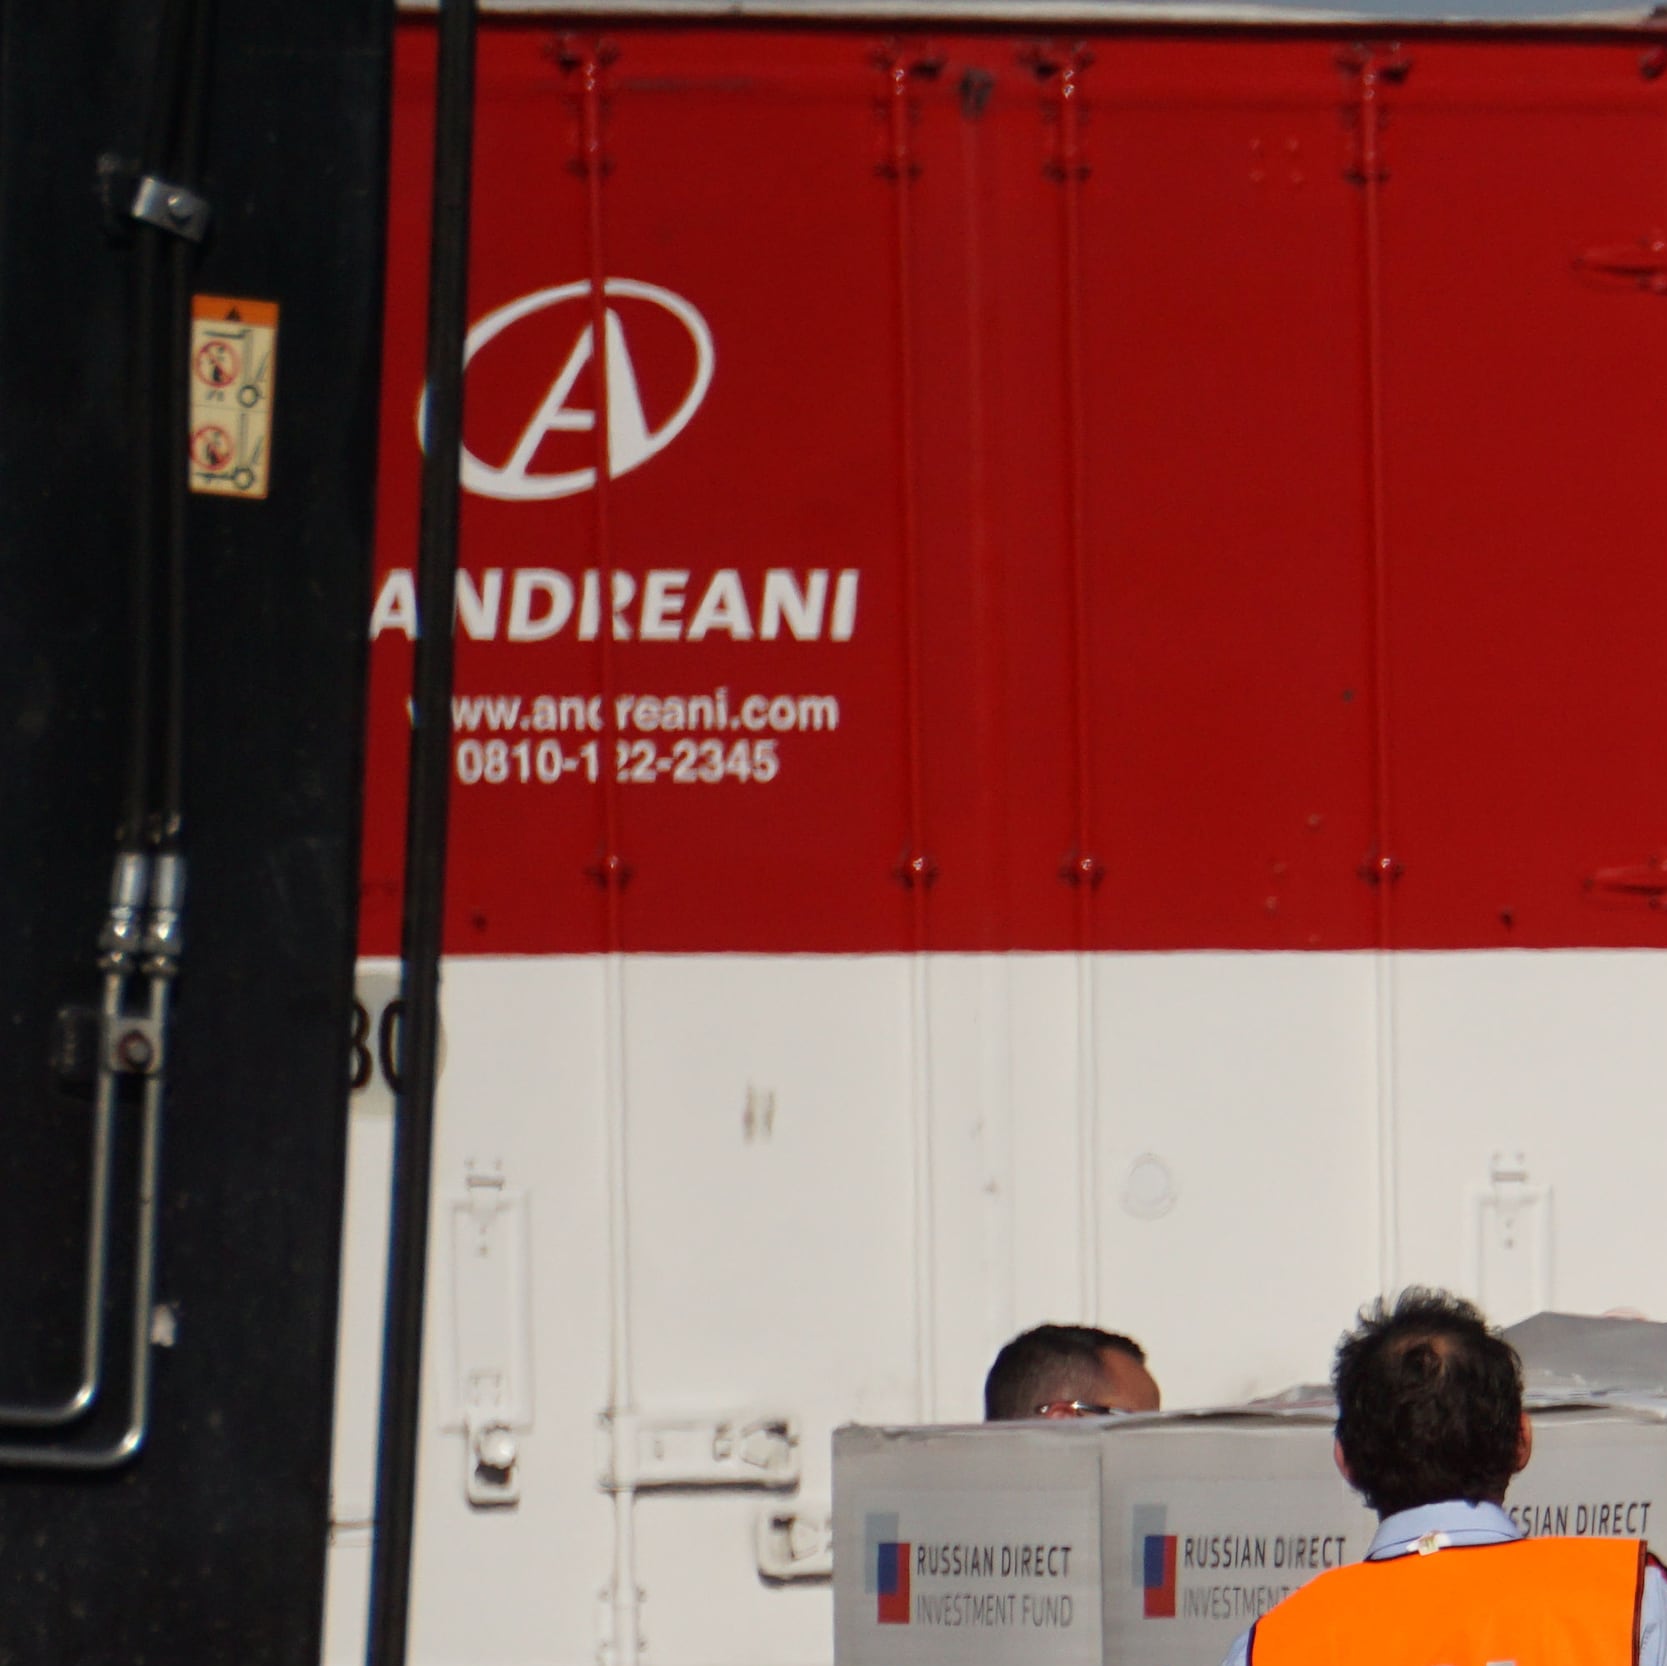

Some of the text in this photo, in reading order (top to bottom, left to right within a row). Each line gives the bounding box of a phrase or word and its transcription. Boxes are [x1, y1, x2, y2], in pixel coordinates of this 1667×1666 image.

[368, 566, 861, 642] ANDREANI
[1575, 1502, 1652, 1536] DIRECT
[916, 1546, 1073, 1578] RUSSIAN DIRECT
[1184, 1535, 1347, 1569] RUSSIAN DIRECT
[916, 1594, 1073, 1627] INVESTMENT FUND
